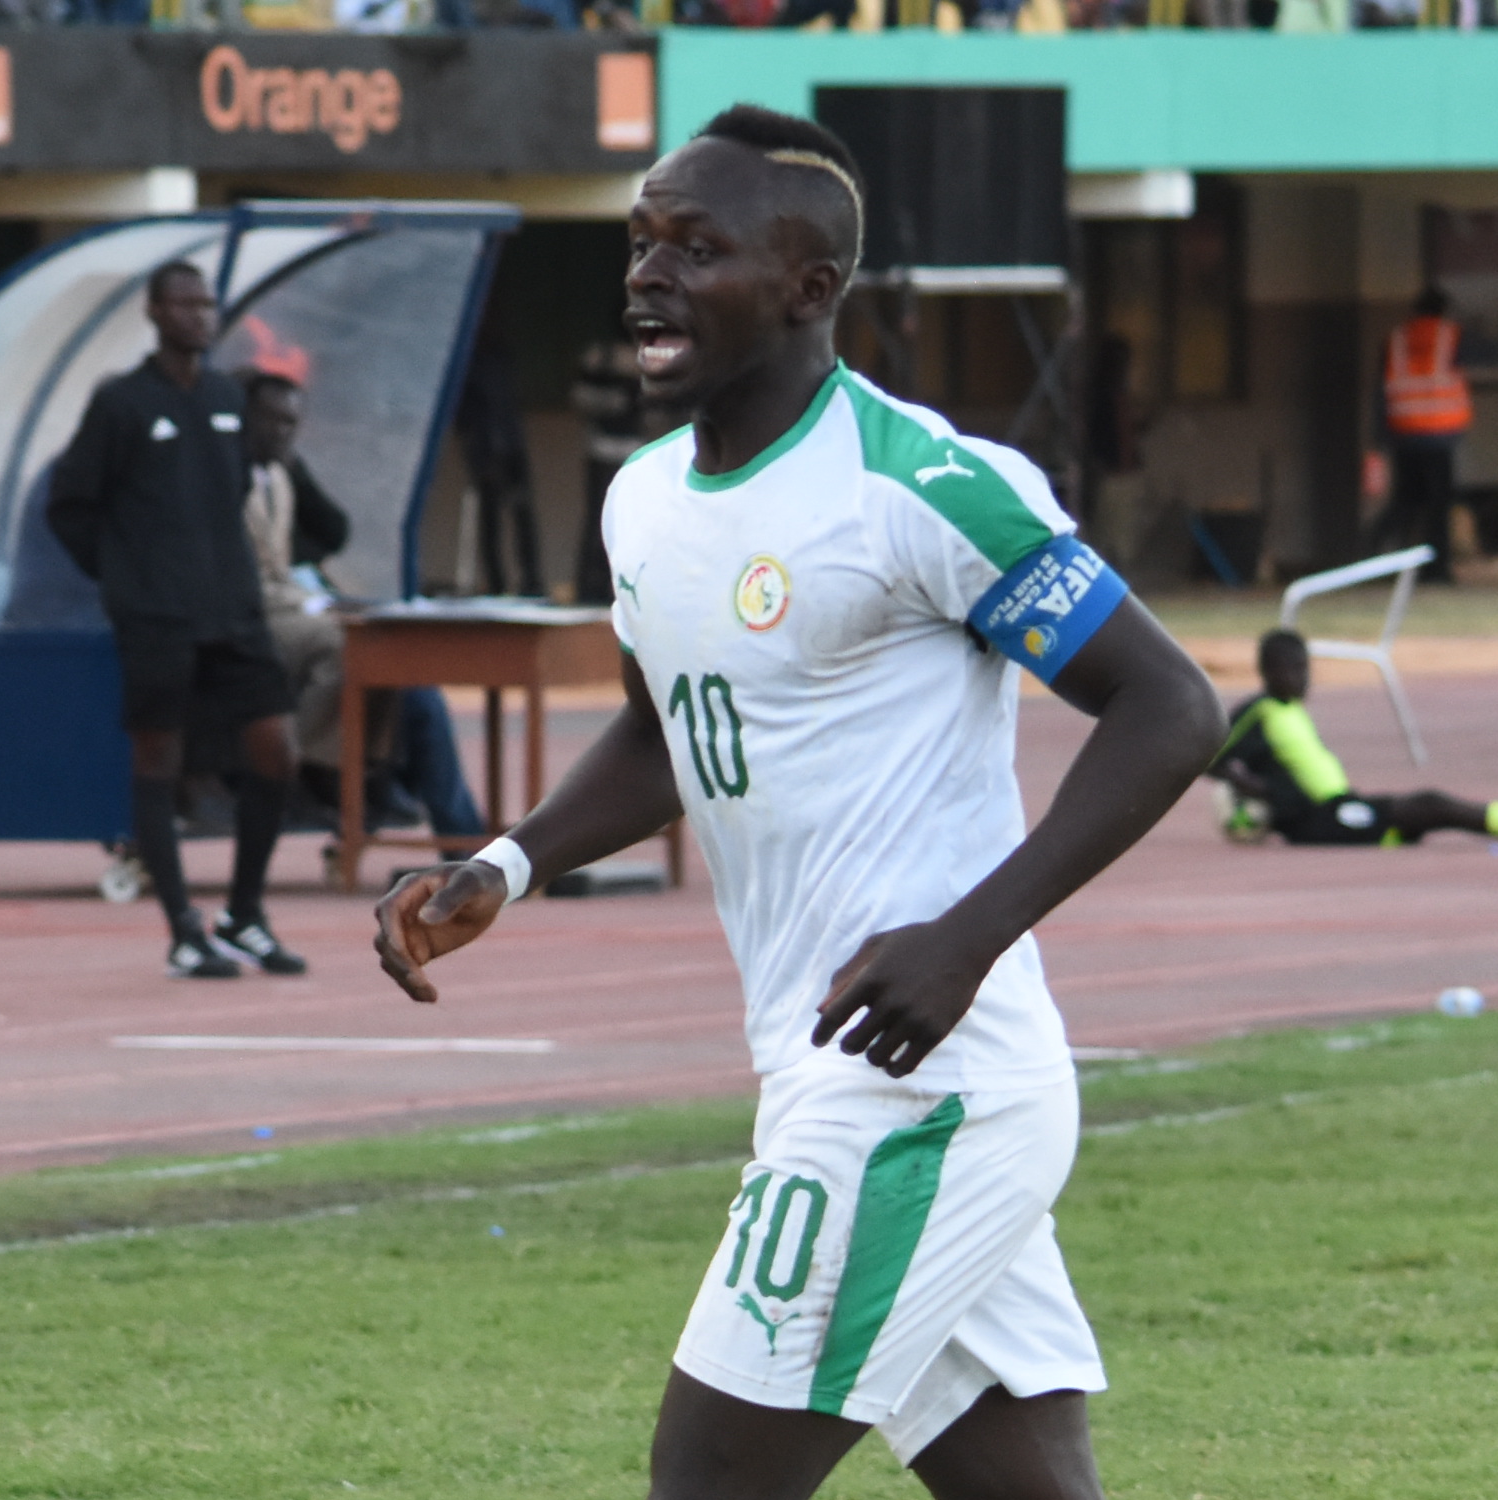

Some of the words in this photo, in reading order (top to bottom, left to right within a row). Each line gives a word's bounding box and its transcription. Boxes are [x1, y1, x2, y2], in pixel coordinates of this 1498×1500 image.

[201, 46, 402, 153] Orange
[1012, 567, 1043, 598] FAIR
[1035, 544, 1105, 616] FIFA
[1040, 553, 1054, 569] IS
[1041, 563, 1062, 585] MY
[1004, 585, 1042, 624] GAME
[668, 673, 749, 799] 10
[725, 1172, 828, 1302] 10
